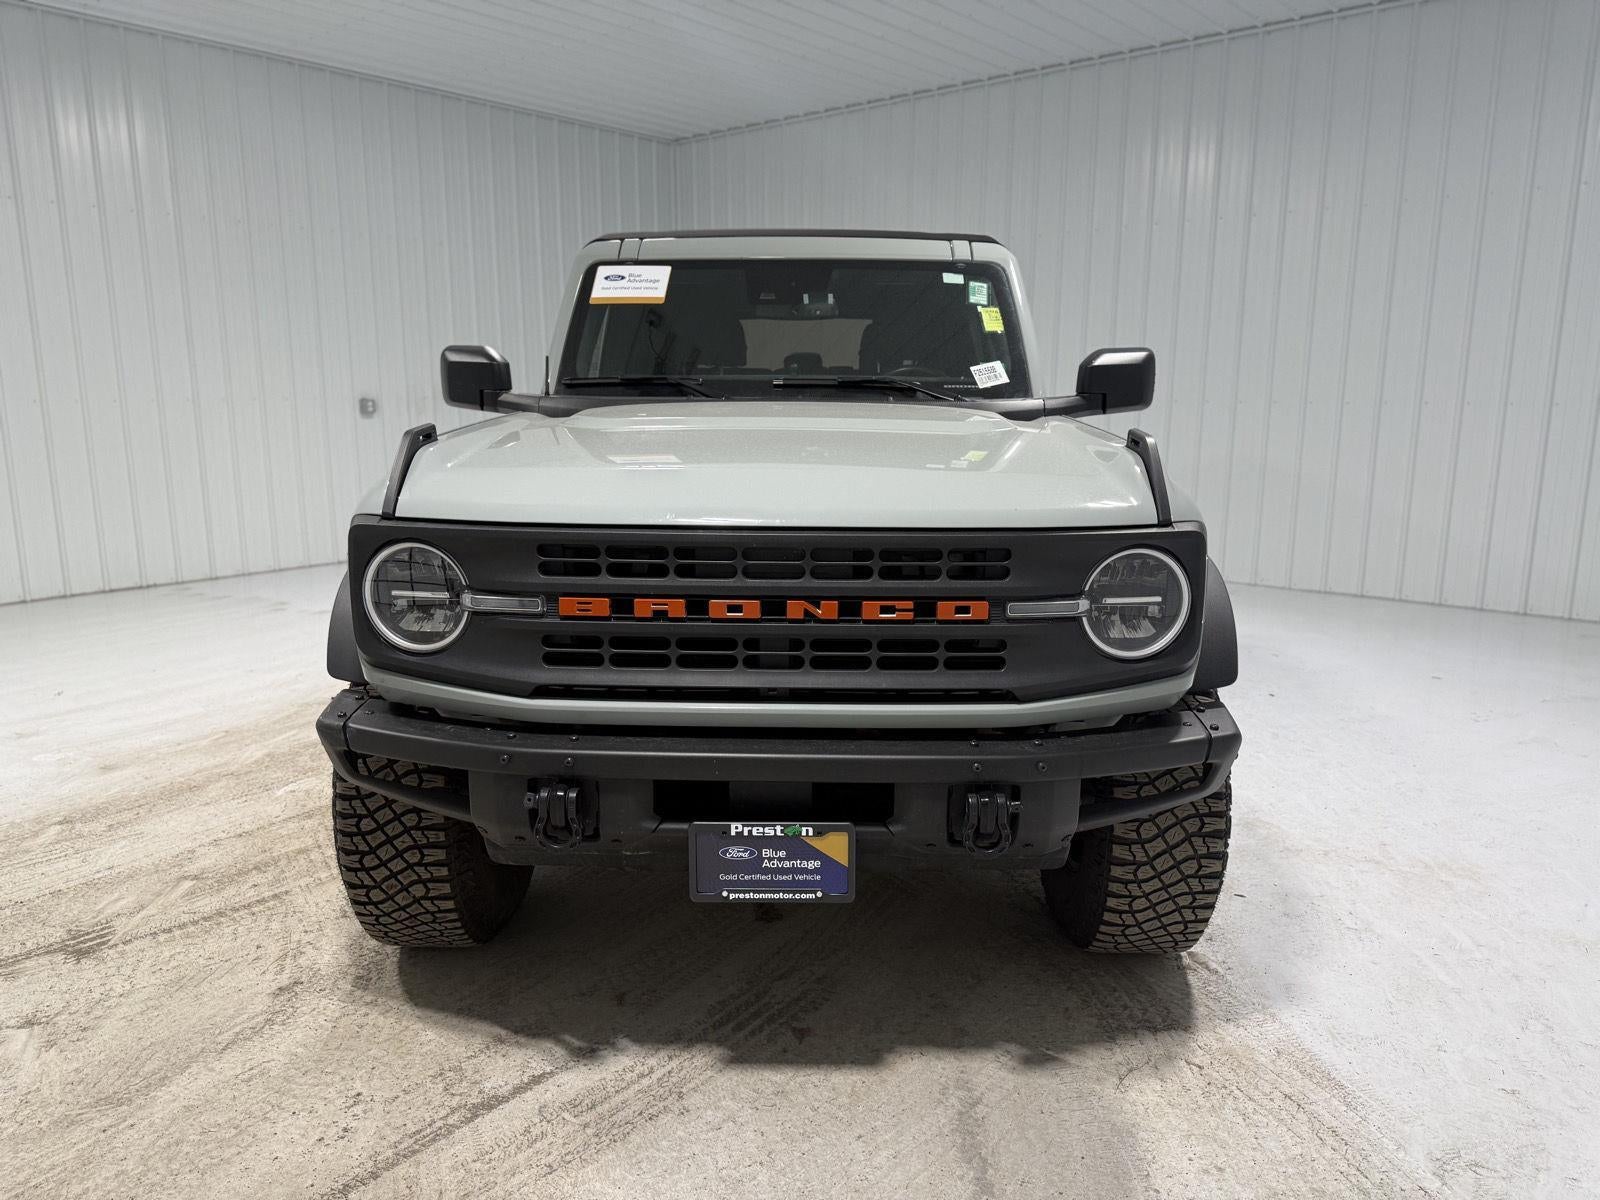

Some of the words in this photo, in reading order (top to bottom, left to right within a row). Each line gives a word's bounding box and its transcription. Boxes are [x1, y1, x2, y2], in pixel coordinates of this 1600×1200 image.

[558, 596, 990, 623] BRONCO
[723, 846, 752, 859] Ford
[762, 848, 787, 858] Blue
[762, 859, 821, 870] Advantage
[719, 873, 738, 881] Gold
[739, 873, 771, 881] Certified
[772, 873, 793, 881] Used
[794, 873, 821, 881] Vehicle
[729, 890, 816, 900] prestonmotor.com
